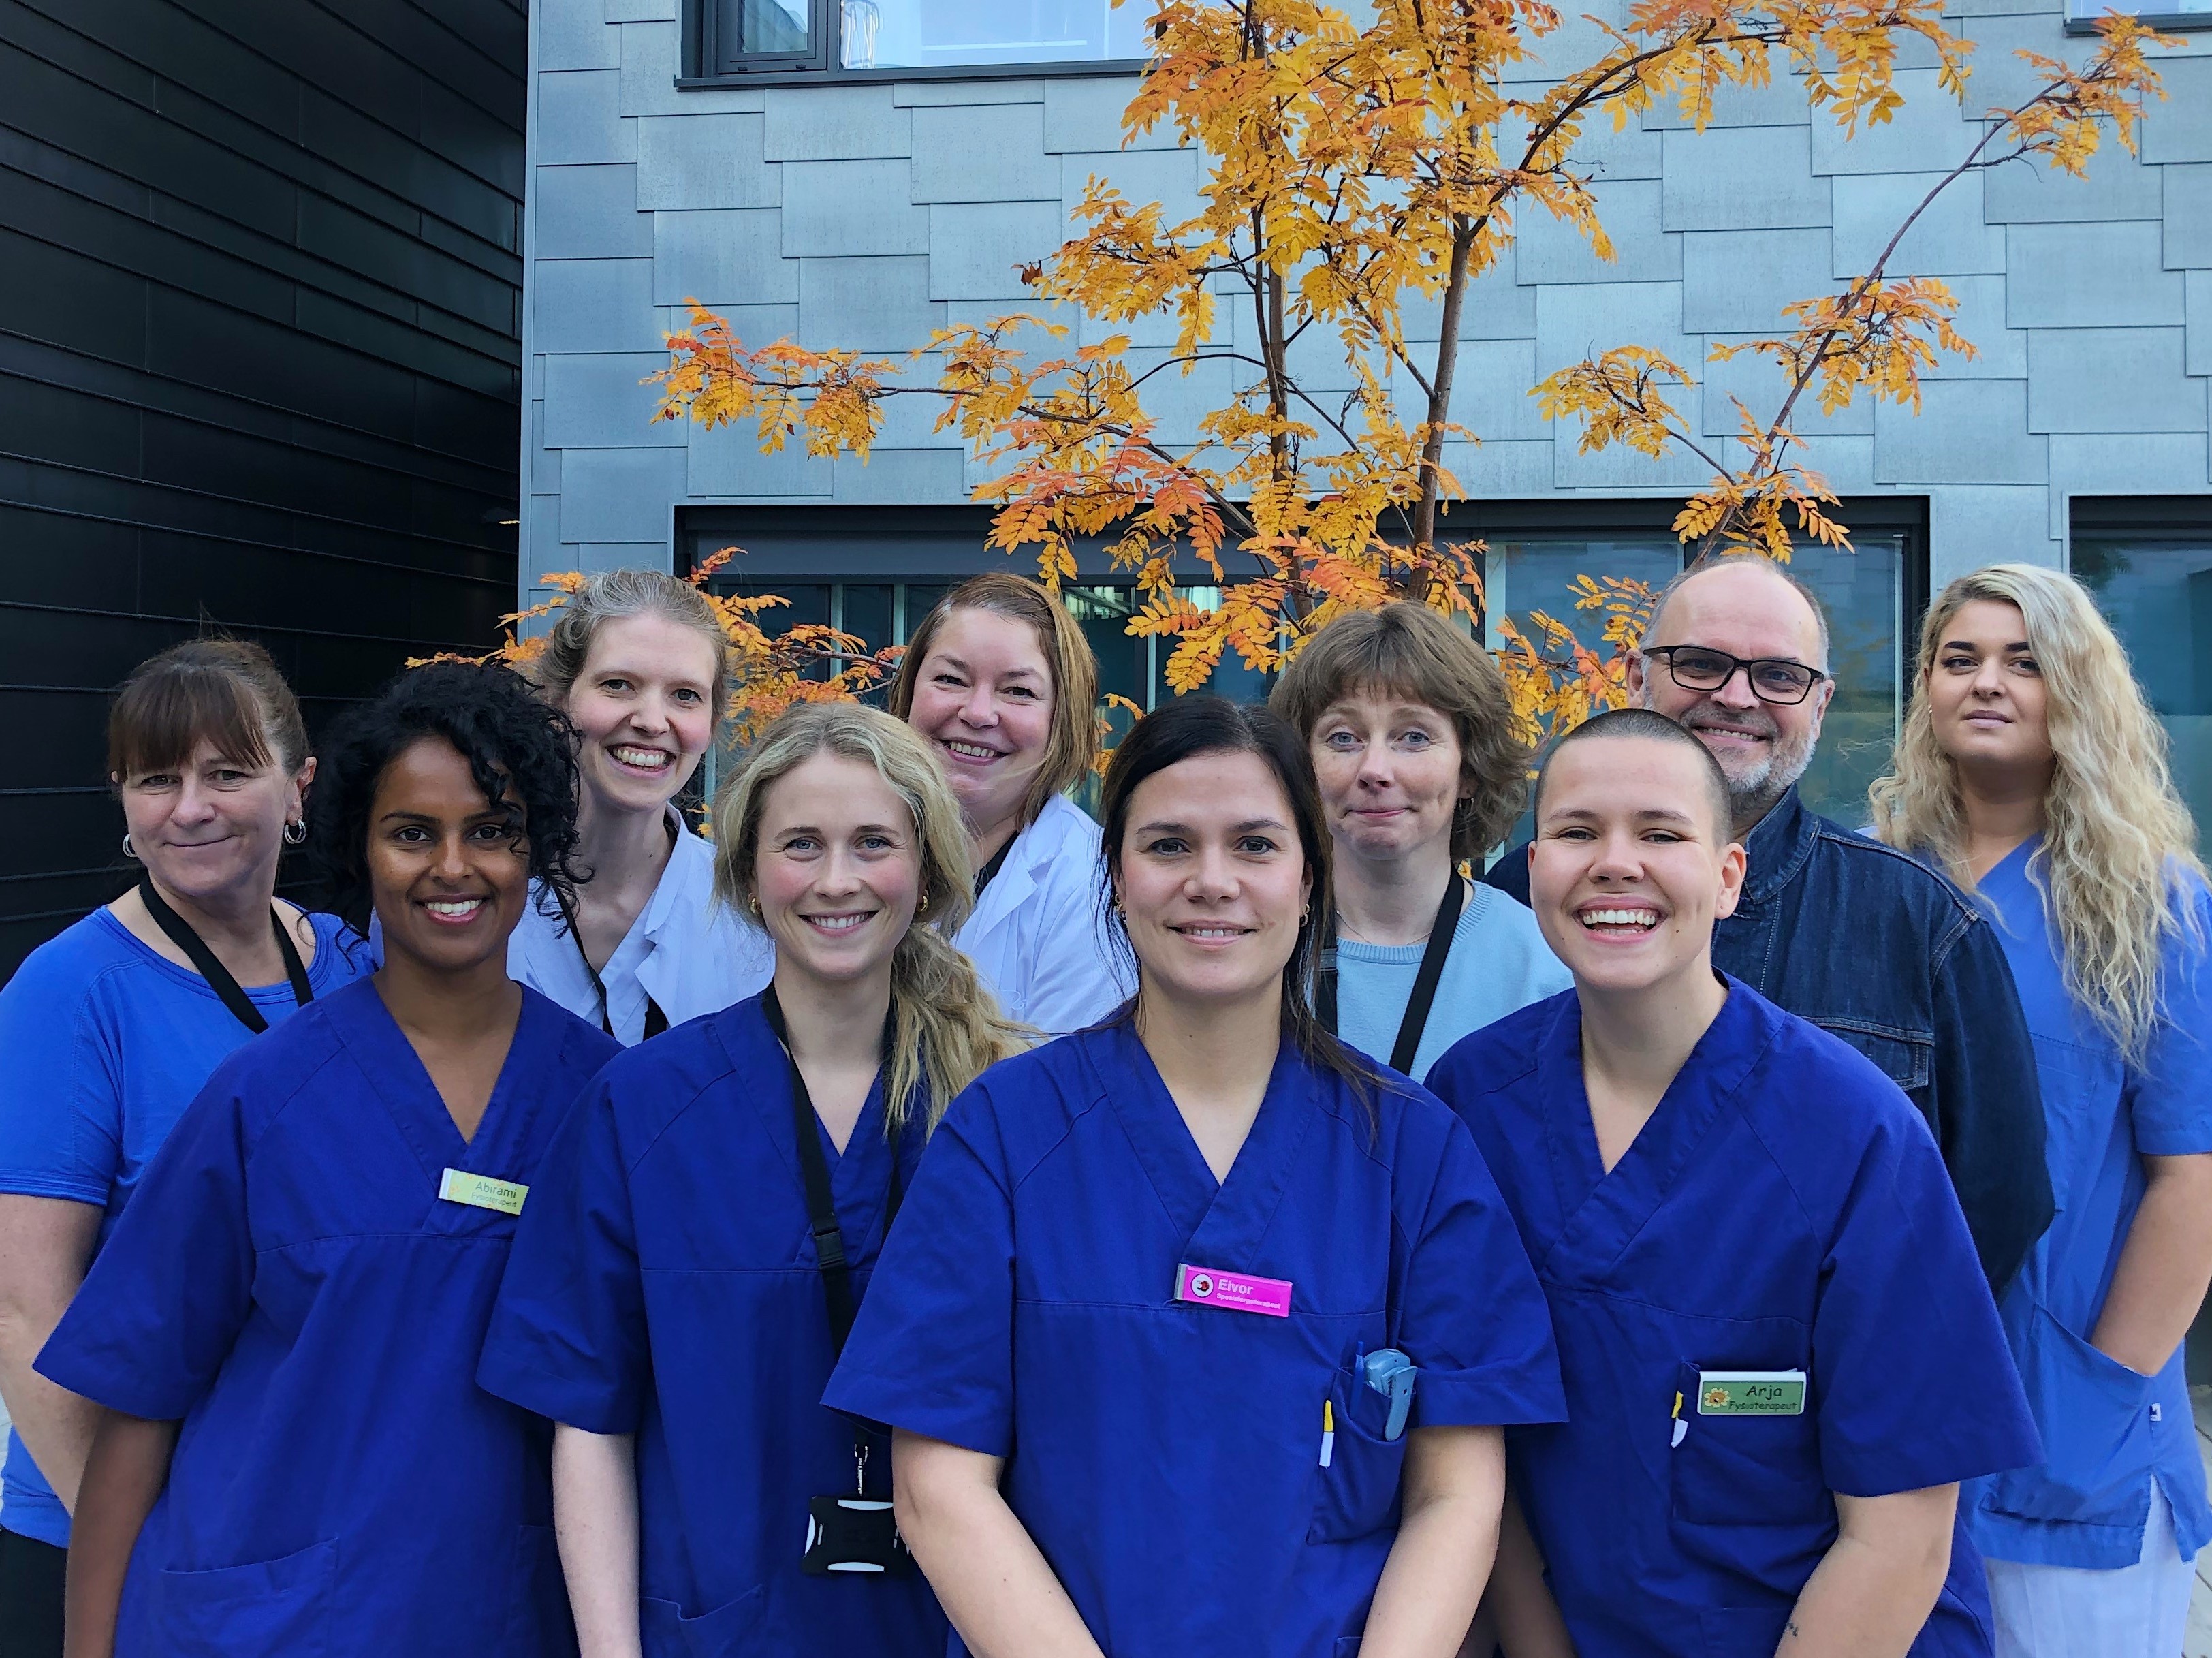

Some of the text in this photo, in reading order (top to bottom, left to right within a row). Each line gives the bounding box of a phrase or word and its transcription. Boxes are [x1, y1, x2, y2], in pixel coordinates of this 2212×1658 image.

[475, 1181, 517, 1199] Abirami
[1218, 1279, 1254, 1295] Eivor
[1746, 1385, 1782, 1400] Arja
[1728, 1401, 1797, 1411] Fysioterapeut
